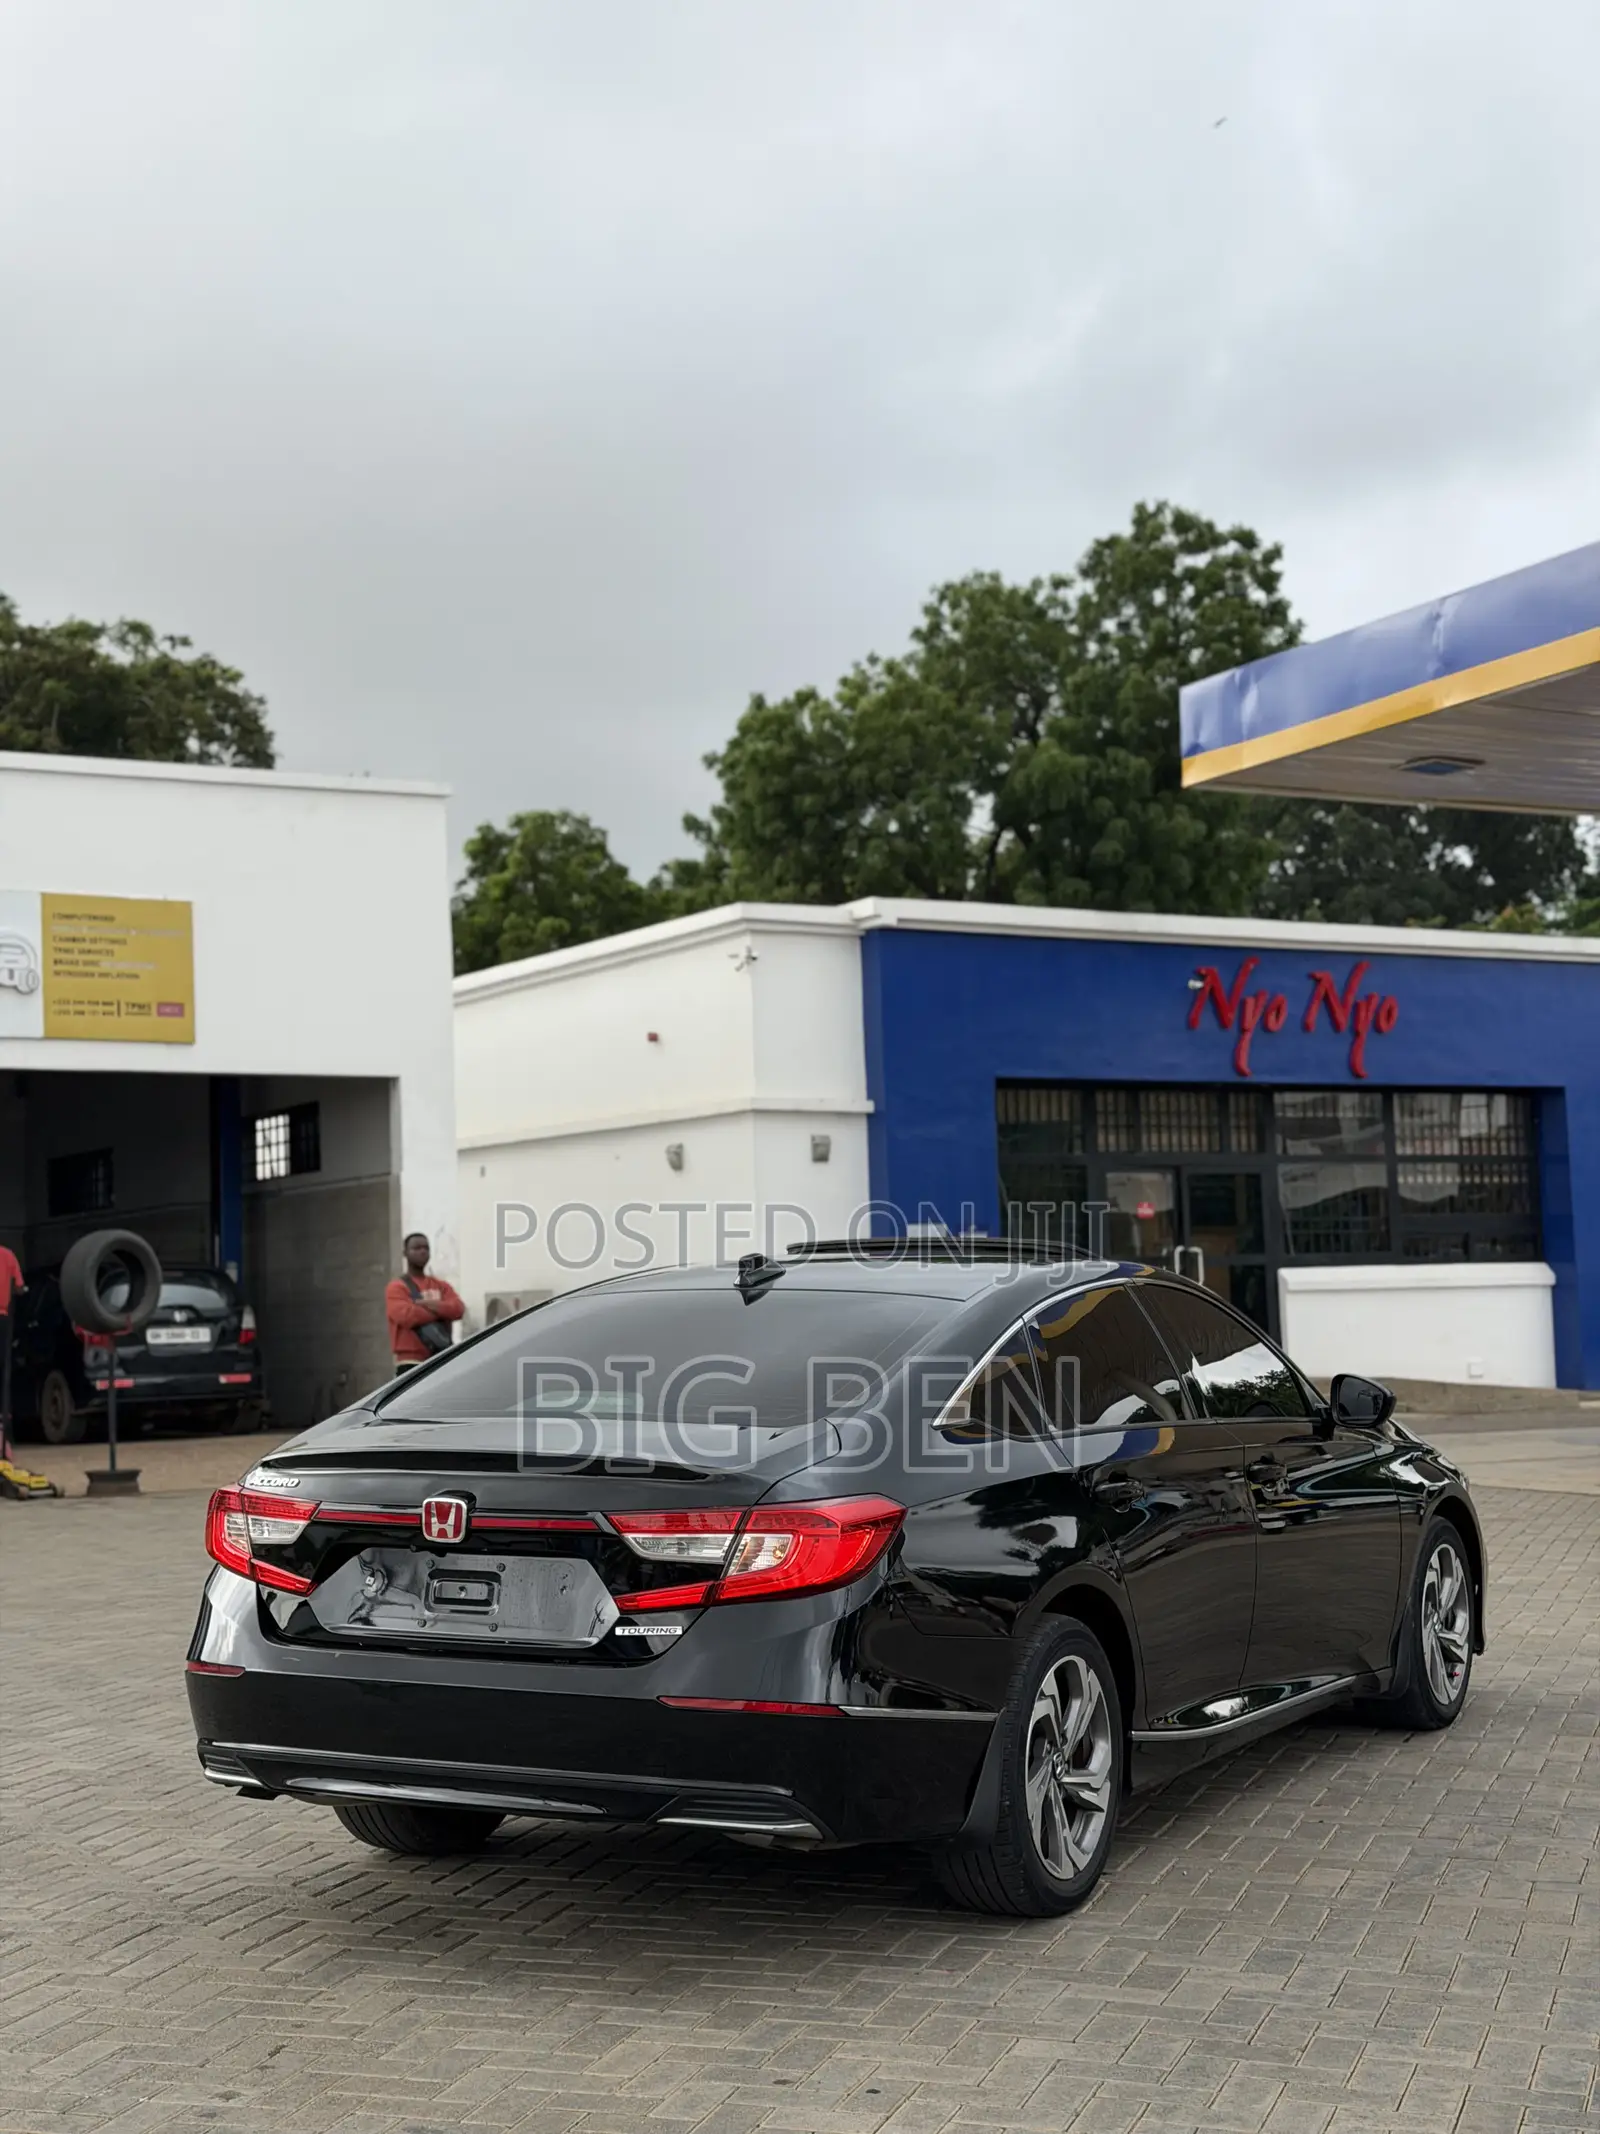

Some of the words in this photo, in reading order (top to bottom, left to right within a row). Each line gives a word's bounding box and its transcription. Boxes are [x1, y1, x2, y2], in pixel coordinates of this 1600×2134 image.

[1187, 956, 1288, 1077] Nyo
[1303, 960, 1399, 1079] Nyo
[249, 1477, 301, 1488] ACCORD
[619, 1627, 679, 1635] TOURING
